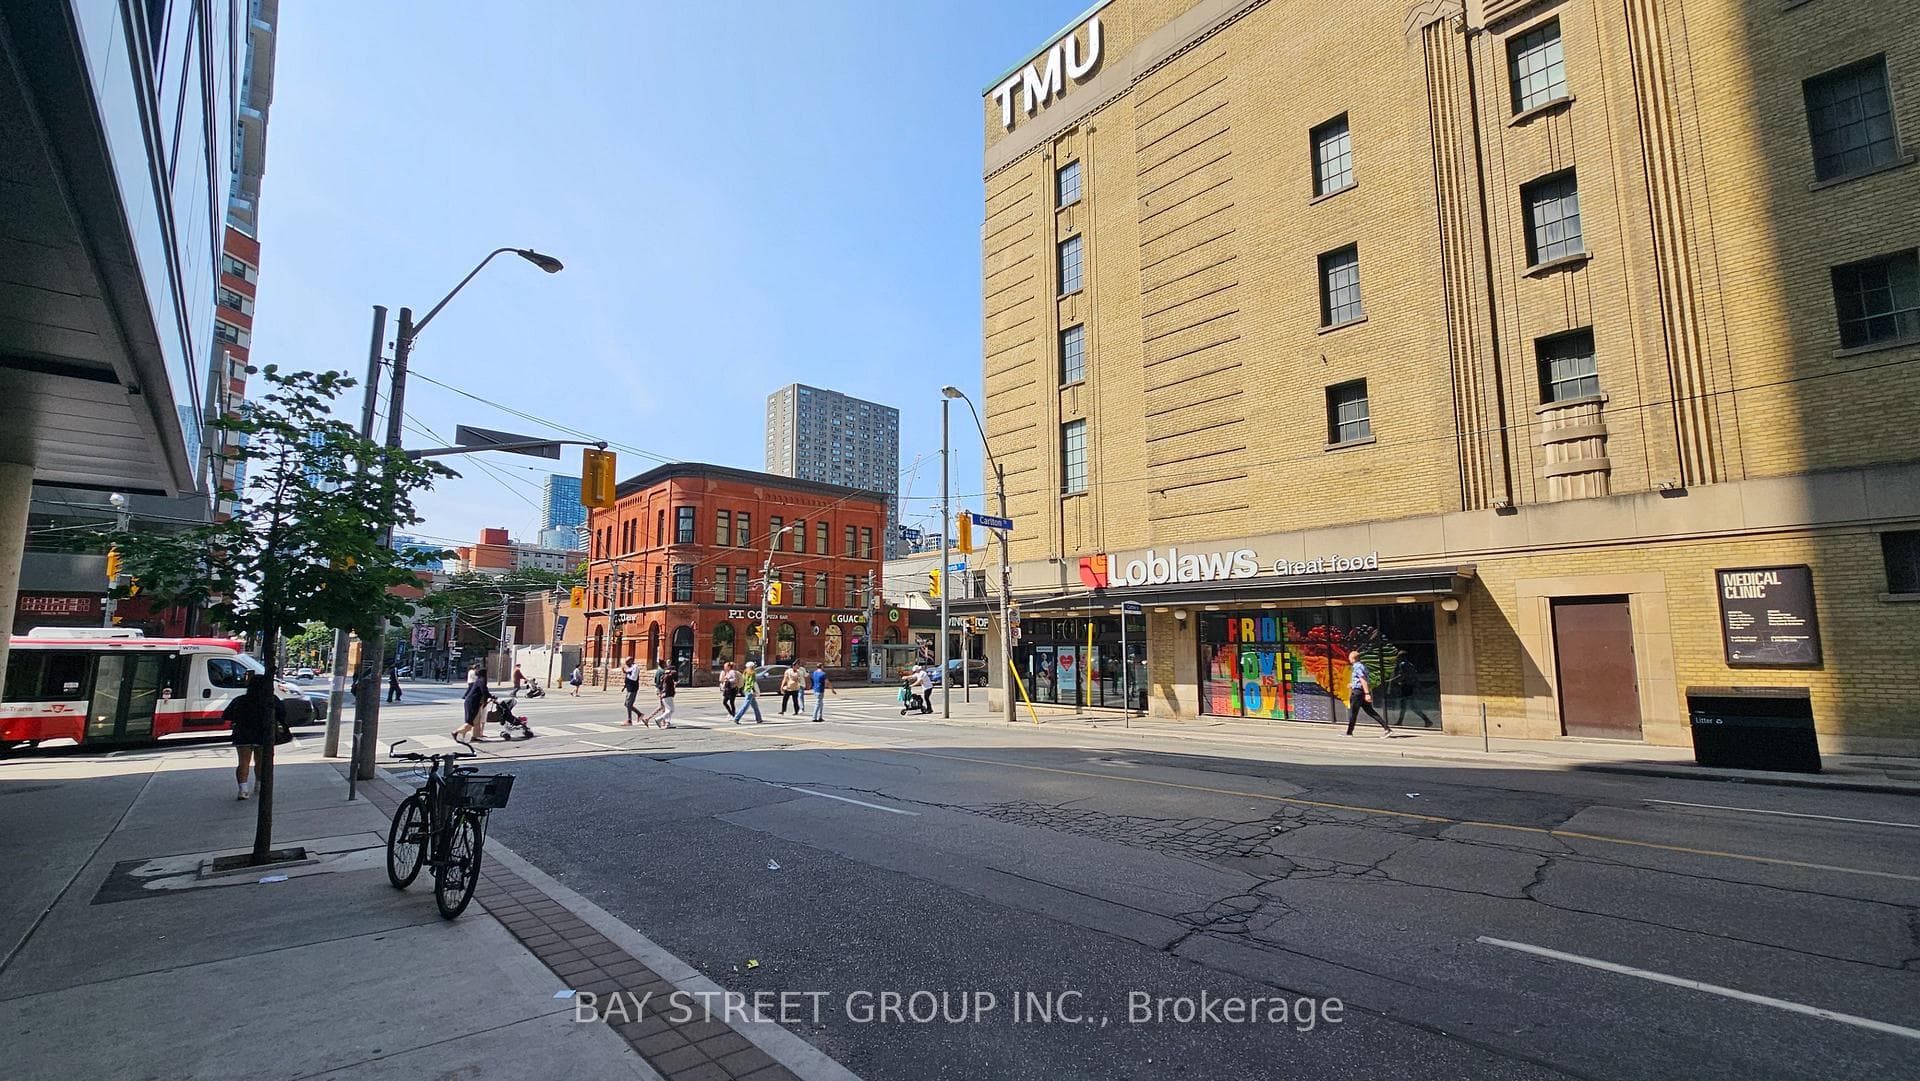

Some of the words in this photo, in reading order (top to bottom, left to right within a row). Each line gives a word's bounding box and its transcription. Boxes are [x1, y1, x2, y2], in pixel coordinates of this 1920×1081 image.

[992, 16, 1101, 130] TMU
[980, 516, 1002, 527] Carlton
[1107, 547, 1259, 588] Loblaws
[1273, 558, 1326, 576] Great
[1331, 551, 1379, 572] food
[1723, 572, 1782, 586] MEDICAL
[1724, 586, 1766, 599] CLINIC
[728, 609, 745, 619] PI
[837, 614, 859, 623] GUAC
[1228, 616, 1288, 643] PRIDE
[1229, 651, 1291, 681] LOVE
[1262, 675, 1274, 686] IS
[1231, 682, 1294, 712] LOVE
